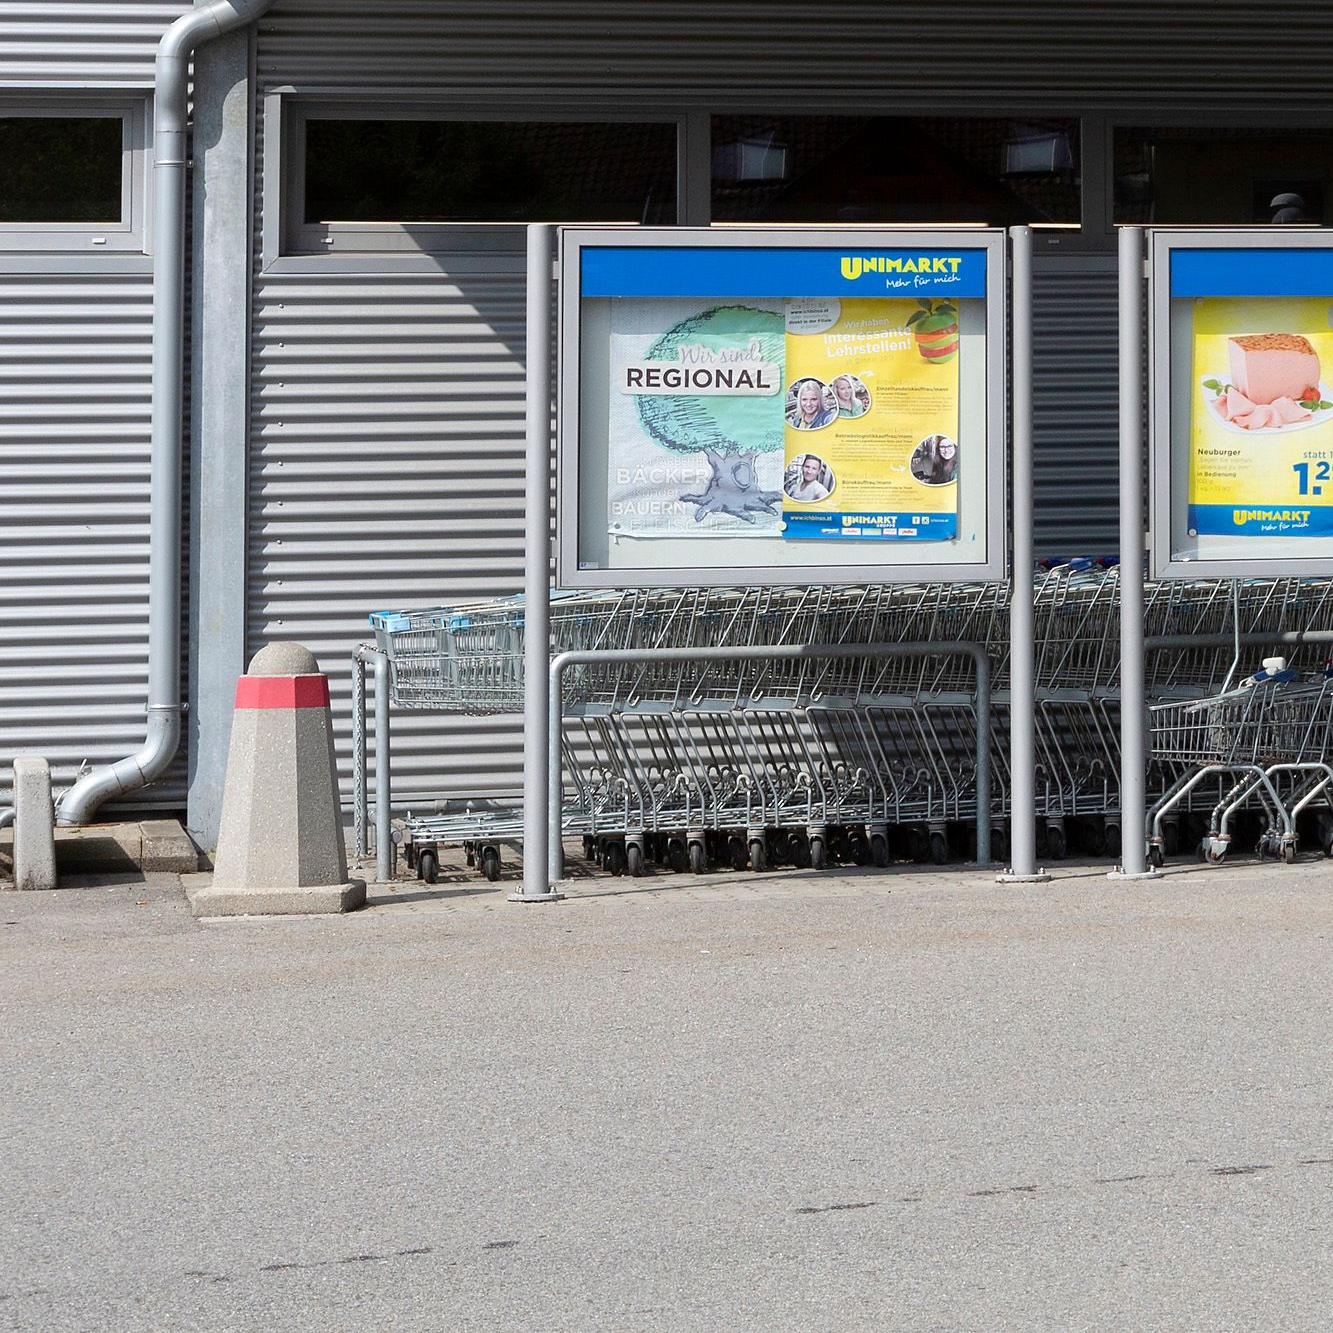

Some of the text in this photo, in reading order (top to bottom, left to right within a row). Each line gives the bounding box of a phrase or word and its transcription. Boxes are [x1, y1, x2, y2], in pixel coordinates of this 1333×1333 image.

[841, 257, 961, 280] UNIMARKT
[886, 273, 961, 289] Mehr für mich
[681, 345, 756, 364] Wir sind
[826, 341, 912, 358] Lehrstellen!
[627, 368, 770, 389] REGIONAL
[1198, 449, 1241, 457] Neuburger
[1303, 451, 1326, 459] statt
[616, 464, 709, 485] BÄCKER
[611, 501, 688, 515] BAUERN
[842, 516, 897, 527] UNIMARKT
[1233, 510, 1310, 525] UNIMARKT
[1279, 522, 1290, 531] für
